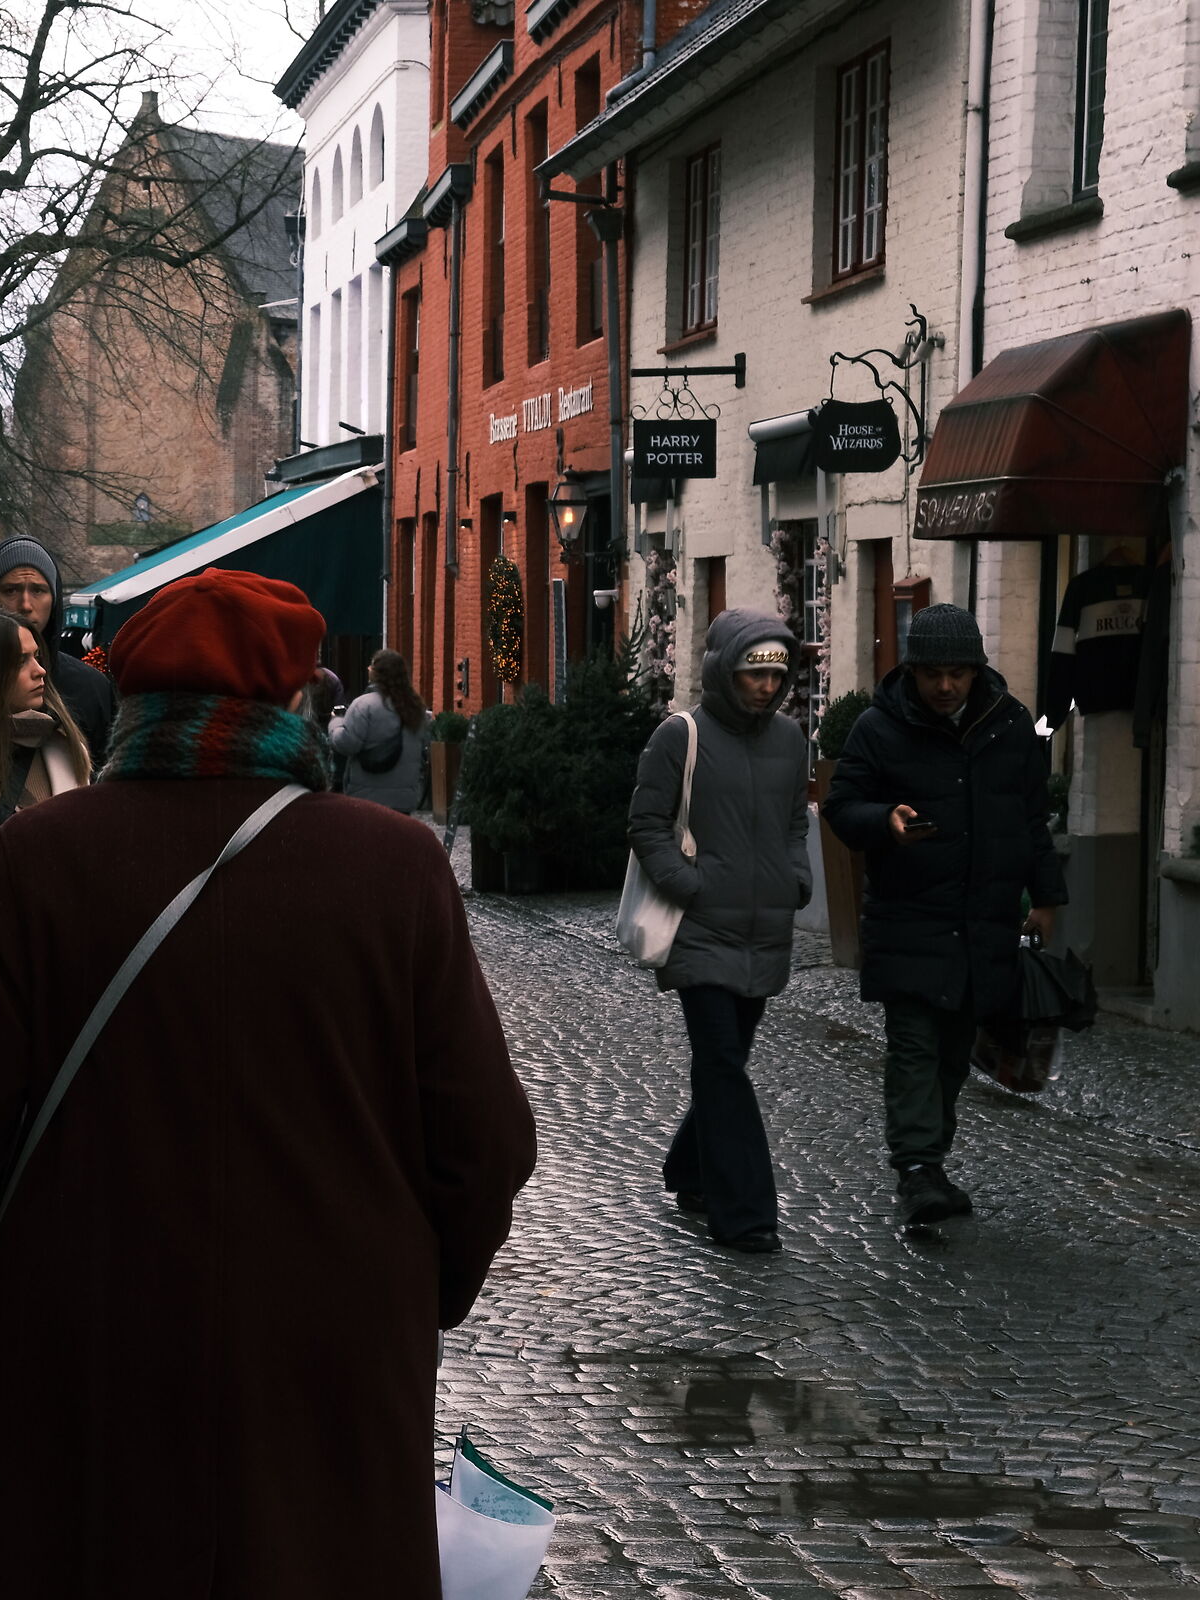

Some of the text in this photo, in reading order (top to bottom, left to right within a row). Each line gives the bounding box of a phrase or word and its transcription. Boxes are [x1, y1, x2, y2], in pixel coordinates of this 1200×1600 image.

[522, 392, 552, 433] VIVALDI
[558, 375, 594, 423] Restaurant
[838, 424, 876, 436] HOUSE
[650, 435, 700, 447] HARRY
[829, 434, 883, 450] WIZARDS
[646, 452, 704, 465] POTTER
[917, 490, 997, 528] SOUVENRS
